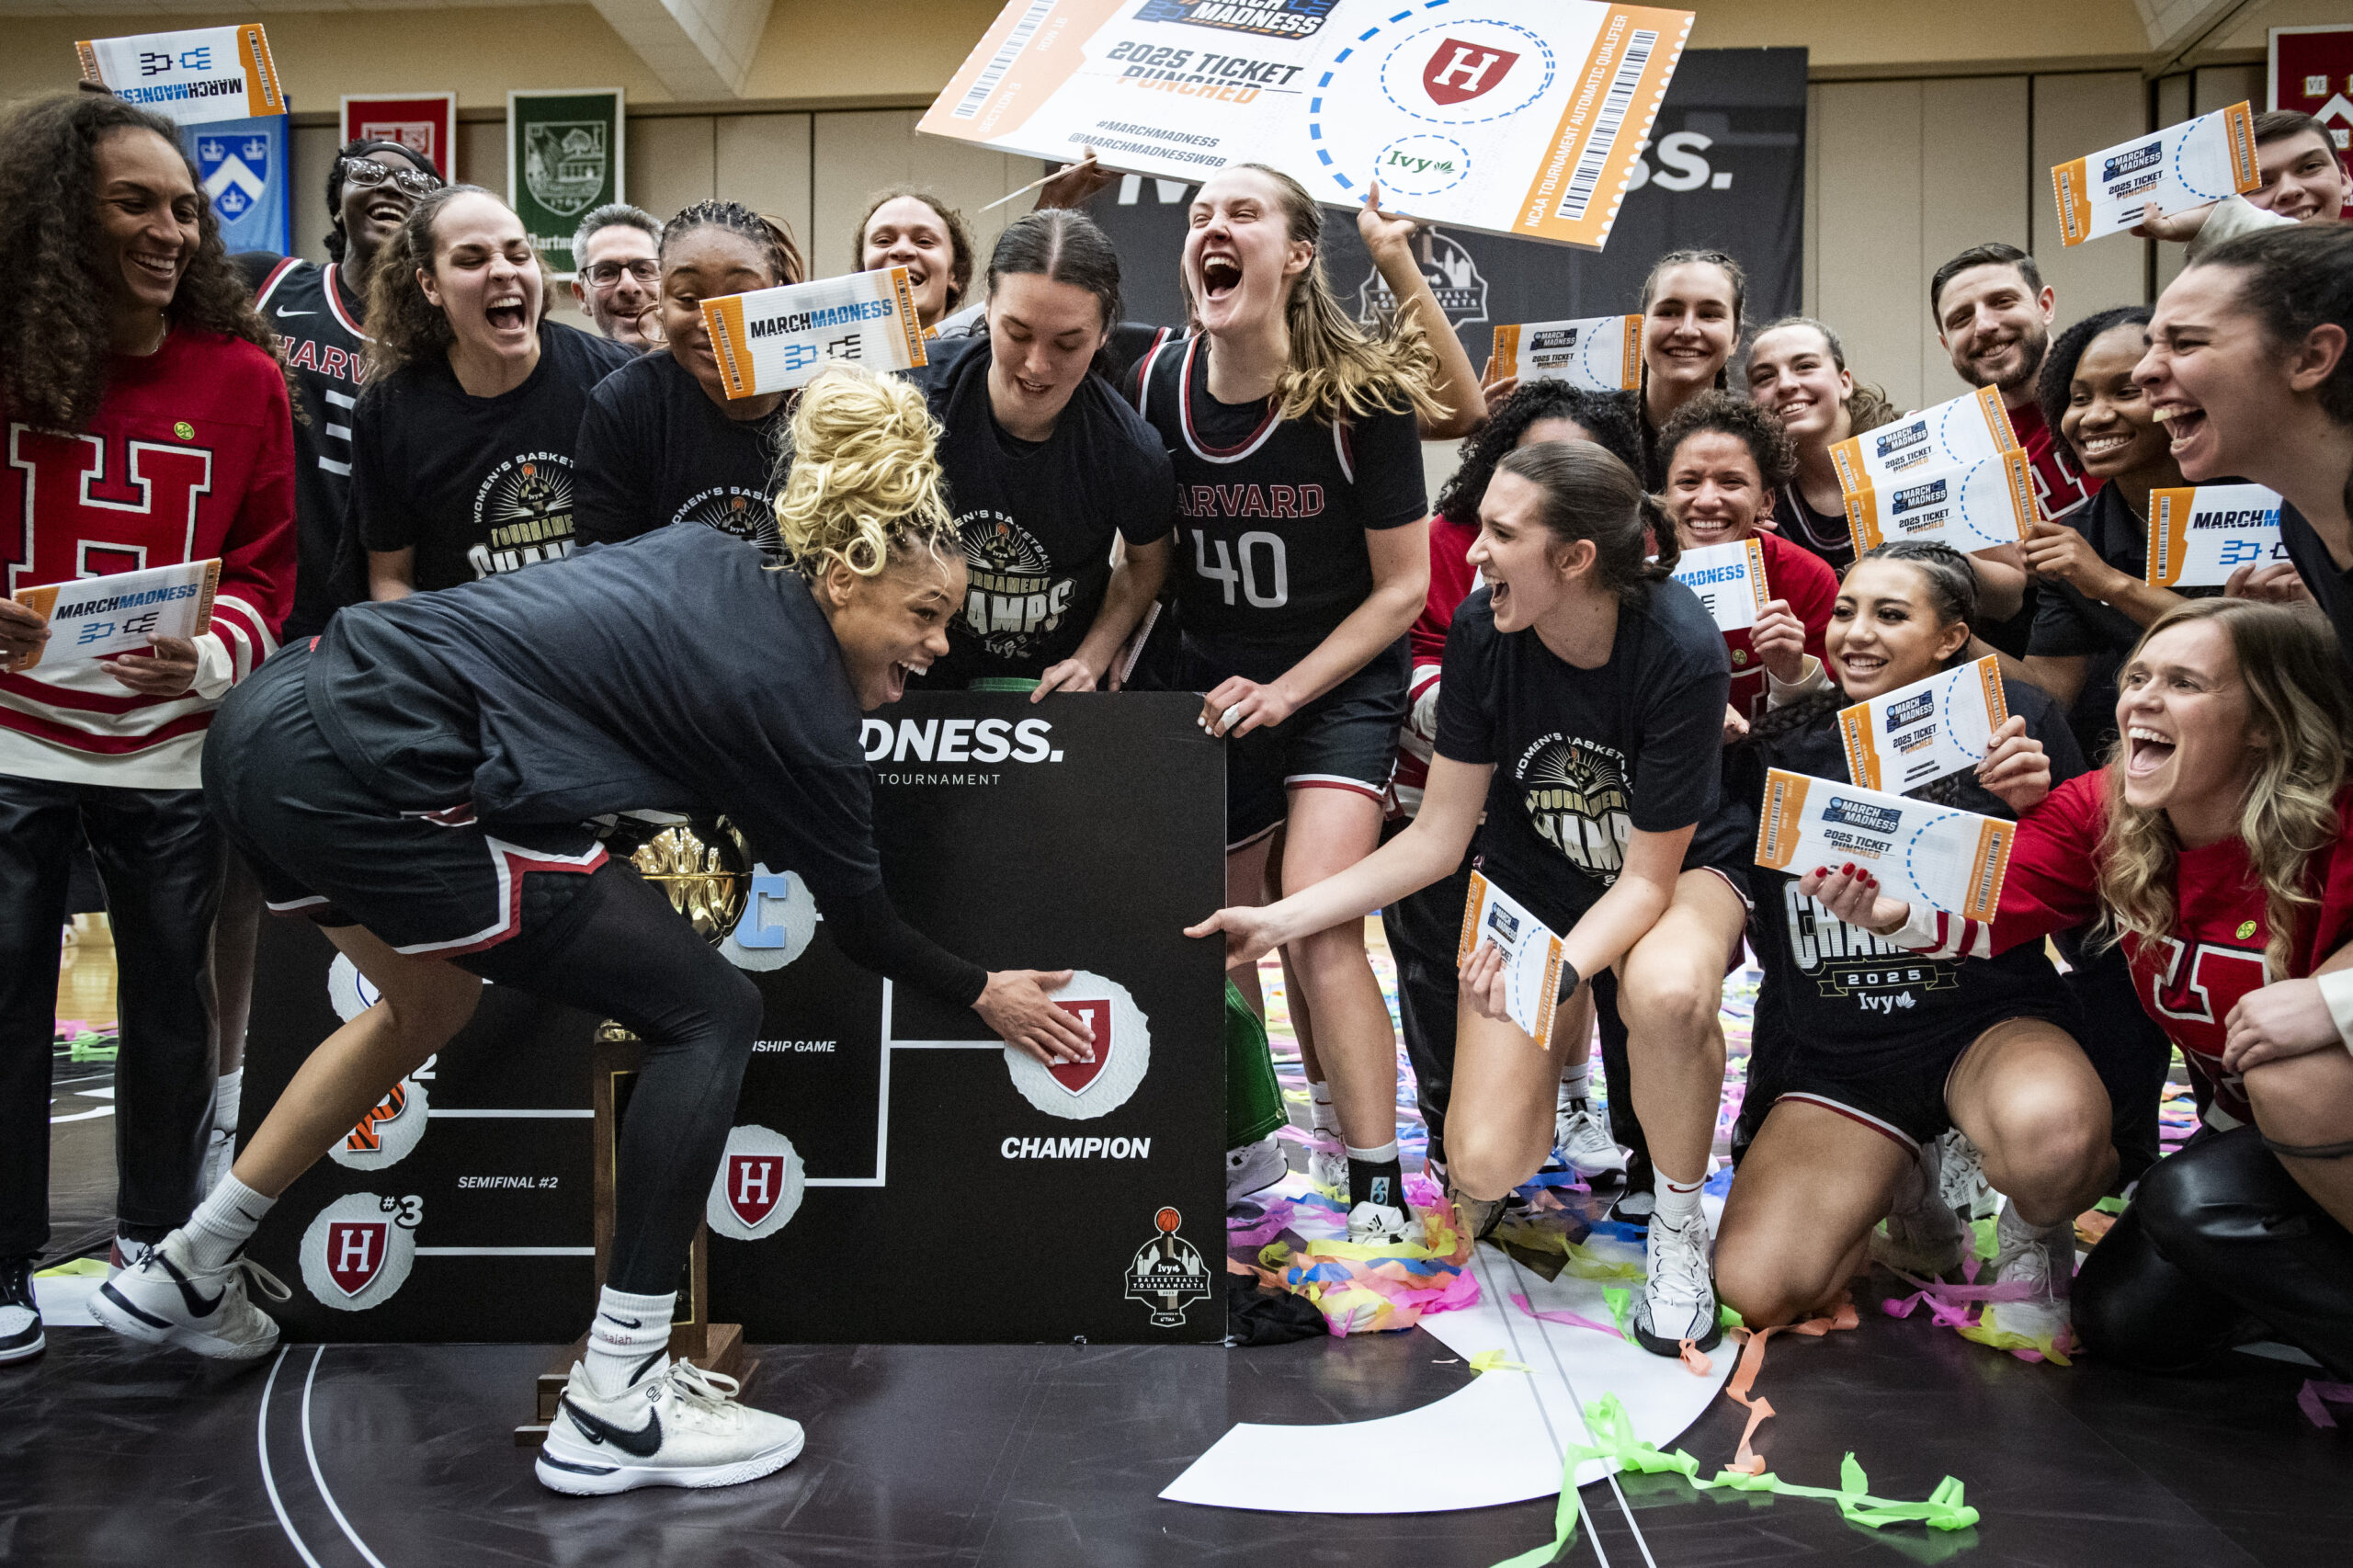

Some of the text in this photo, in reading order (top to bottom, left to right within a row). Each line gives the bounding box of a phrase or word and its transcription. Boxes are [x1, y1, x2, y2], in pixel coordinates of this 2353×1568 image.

[1189, 5, 1324, 35] MADNESS
[1106, 40, 1303, 86] 2025 TICKET
[1431, 45, 1499, 92] H
[1116, 65, 1263, 105] PUNCHED
[977, 90, 1017, 133] SECTION
[1524, 15, 1629, 227] NCAA TOURNAMENT AUTOMATIC QUALIFIER
[1096, 119, 1220, 148] #MARCHMADNESS
[1068, 132, 1227, 168] @MARCHMADNESSWBB
[2114, 149, 2146, 167] MARCH
[1388, 150, 1433, 175] Ivy
[2120, 152, 2162, 173] MADNESS
[2109, 170, 2164, 195] 2025 TICKET
[2116, 182, 2157, 201] PUNCHED
[750, 298, 893, 338] MARCHMADNESS
[1541, 331, 1565, 340] MARCH
[1544, 337, 1576, 347] MADNESS
[1532, 353, 1574, 363] 2025 TICKET
[1885, 427, 1912, 443] MARCH
[1891, 430, 1927, 449] MADNESS
[1884, 446, 1932, 469] 2025 TICKET
[1893, 458, 1929, 474] PUNCHED
[473, 460, 512, 524] WOMEN'S
[1903, 485, 1931, 500] MARCH
[1907, 489, 1947, 507] MADNESS
[1899, 508, 1949, 528] 2025 TICKET
[1906, 519, 1945, 535] PUNCHED
[1191, 528, 1289, 608] 40
[55, 584, 199, 620] MARCHMADNESS
[1894, 697, 1920, 714] MARCH
[1900, 703, 1934, 722] MADNESS
[1893, 723, 1938, 749] 2025 TICKET
[1901, 736, 1934, 755] PUNCHED
[1516, 732, 1563, 779] WOMEN'S
[878, 773, 1001, 785] TOURNAMENT
[1841, 800, 1881, 818] MARCH
[1845, 811, 1897, 832] MADNESS
[1824, 829, 1893, 853] 2025 TICKET
[1830, 840, 1881, 860] PUNCHED
[1847, 969, 1922, 985] 2025
[1858, 992, 1895, 1015] Ivy
[794, 1040, 836, 1052] GAME
[1001, 1137, 1151, 1159] CHAMPION
[458, 1176, 558, 1188] SEMIFINAL #2
[738, 1162, 771, 1204] H
[381, 1195, 424, 1227] #3
[336, 1229, 373, 1272] H
[1158, 1264, 1173, 1275] Ivy
